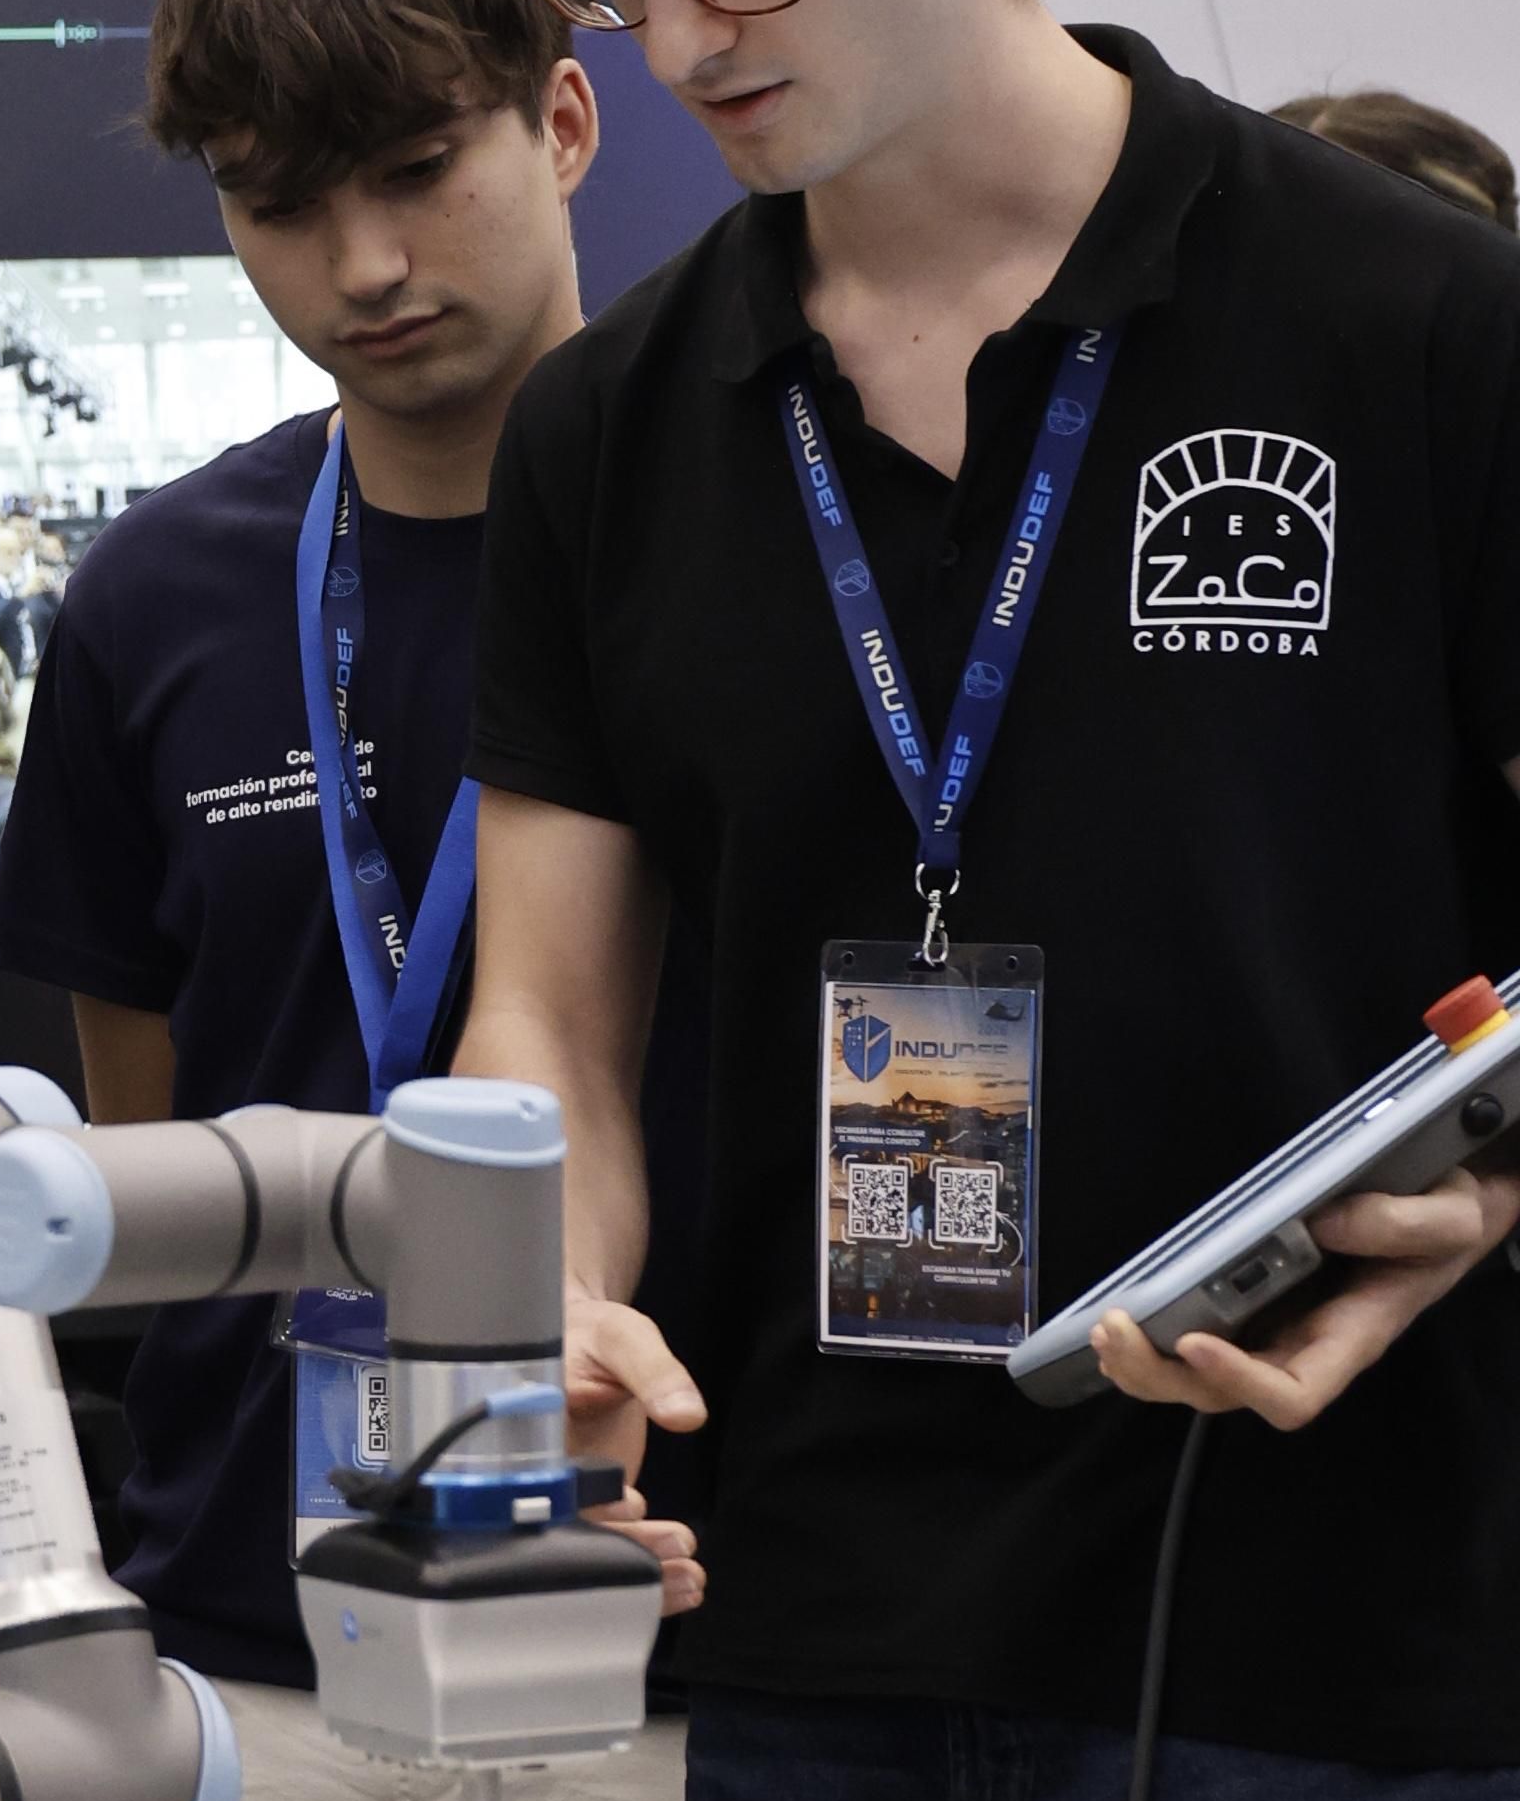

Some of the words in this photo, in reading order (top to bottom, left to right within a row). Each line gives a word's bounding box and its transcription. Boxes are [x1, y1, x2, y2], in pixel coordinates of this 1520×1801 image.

[788, 385, 842, 527] INDUDEF
[993, 472, 1053, 627] INDUDEF
[1133, 625, 1319, 656] CÓRDOBA
[861, 629, 926, 777] INDUDEF
[186, 777, 266, 807] formación
[206, 808, 226, 824] de
[228, 800, 262, 820] alto
